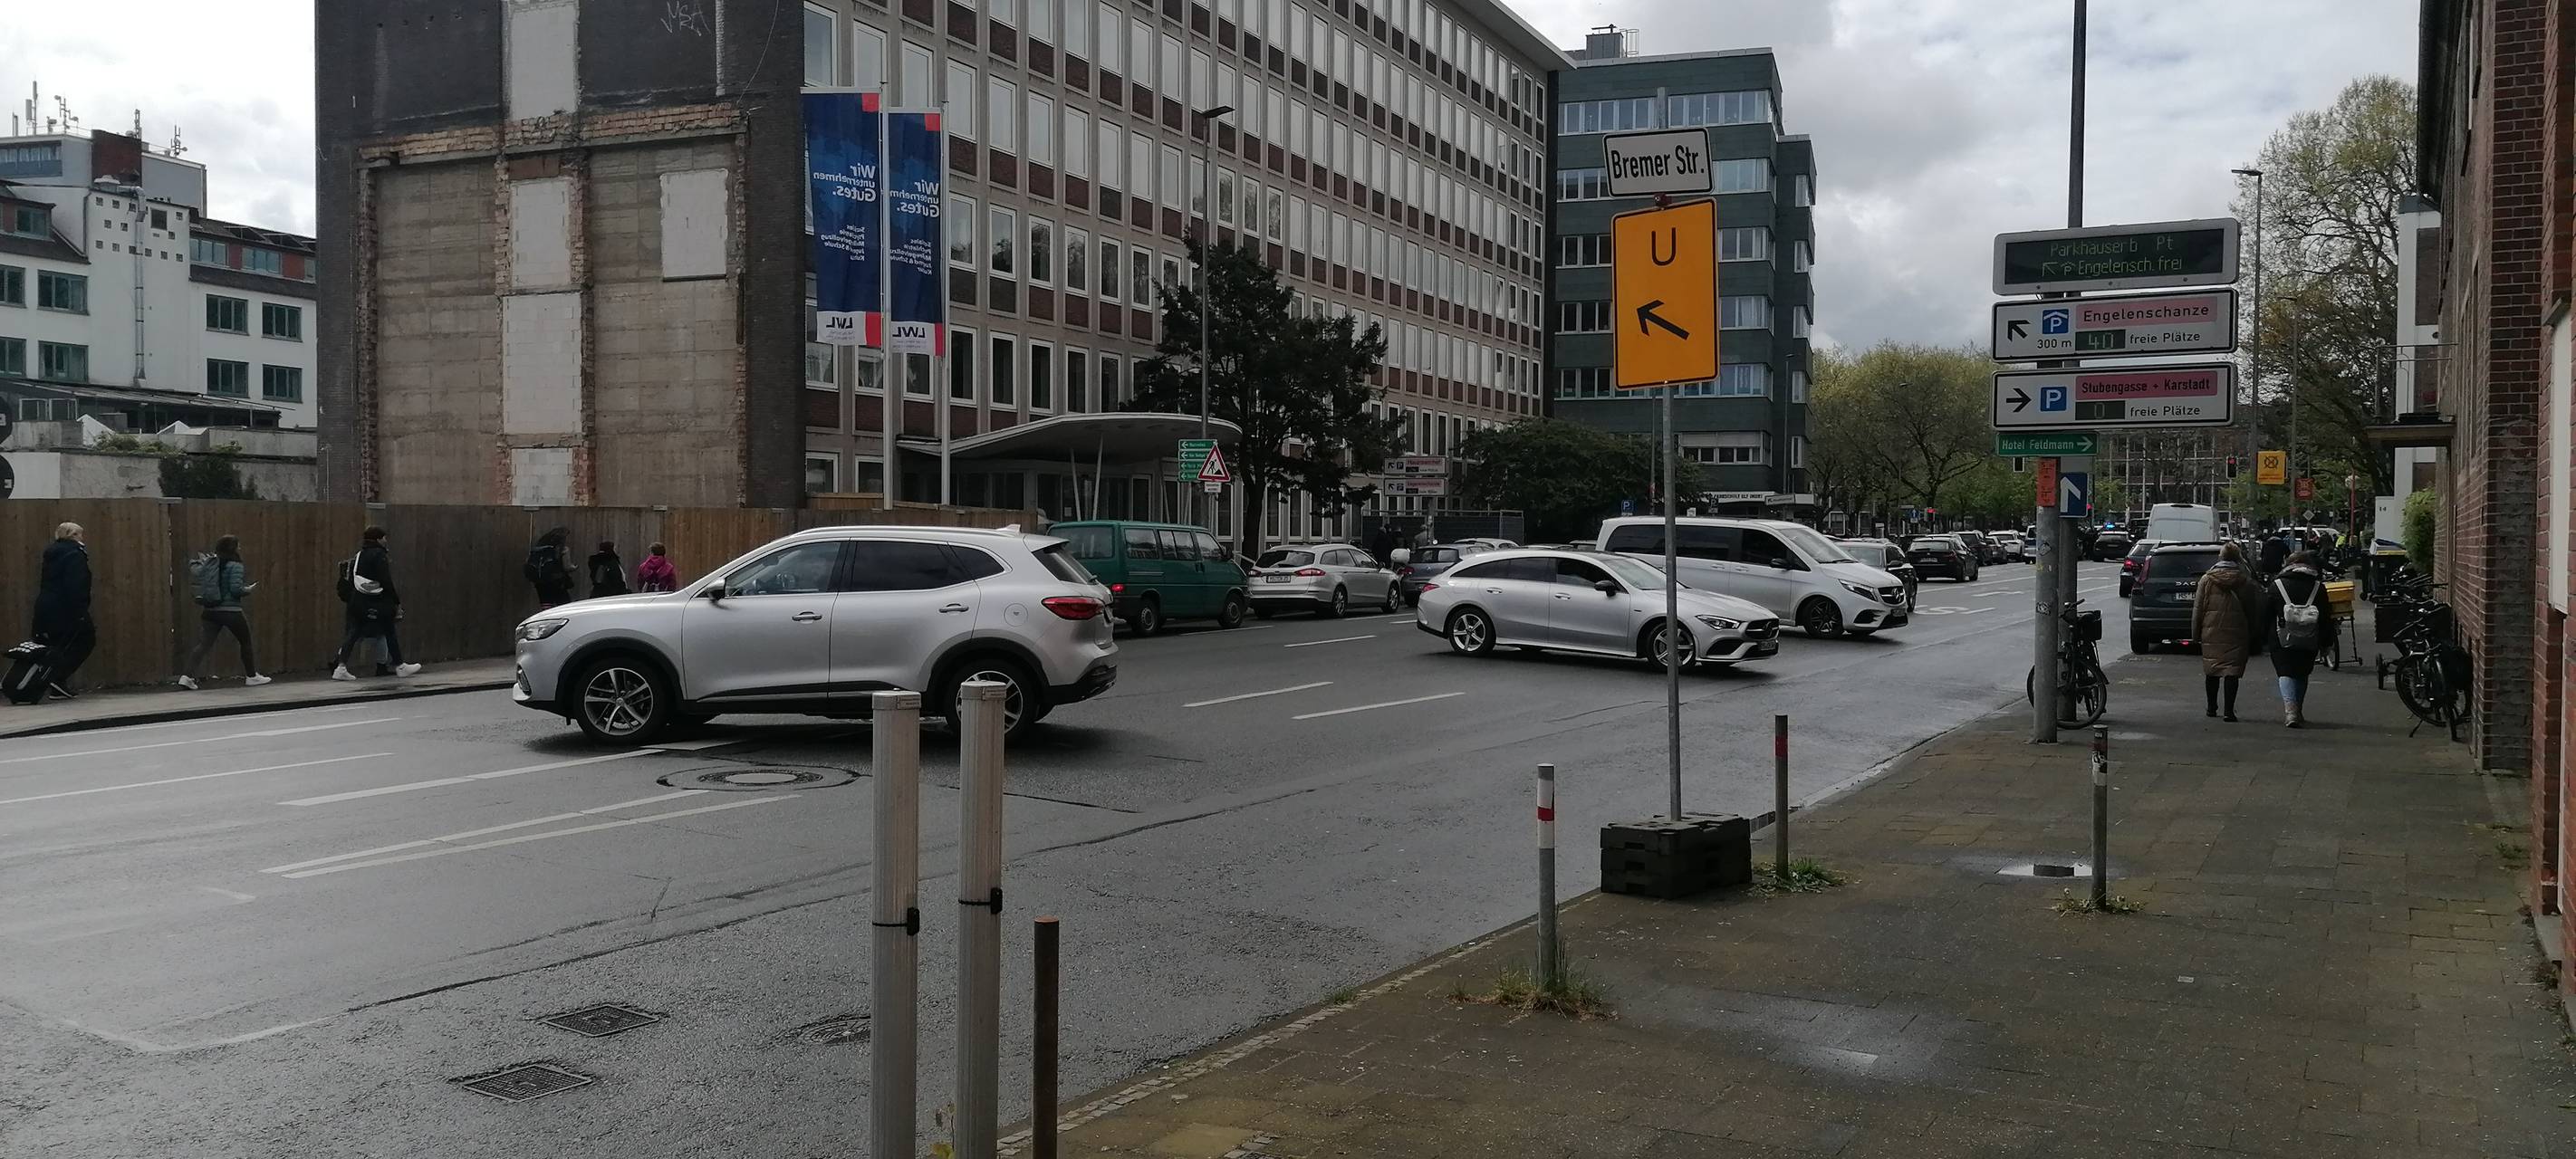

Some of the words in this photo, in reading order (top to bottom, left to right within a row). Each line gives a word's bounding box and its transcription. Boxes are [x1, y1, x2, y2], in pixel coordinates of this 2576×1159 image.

[1610, 149, 1670, 178] Bremer
[1675, 145, 1705, 175] Str.
[1651, 227, 1676, 266] U
[2158, 255, 2182, 271] frei
[2083, 304, 2209, 323] Engelenschanze
[2037, 339, 2057, 349] 300
[2129, 333, 2158, 344] freie
[2163, 330, 2201, 344] Plätze
[2081, 381, 2148, 395] Stubengasse
[2164, 378, 2210, 391] Karstadt
[2129, 407, 2158, 417] freie
[2163, 404, 2201, 417] Plätze
[2002, 439, 2025, 450] Hotel
[2029, 438, 2074, 450] Feldmann
